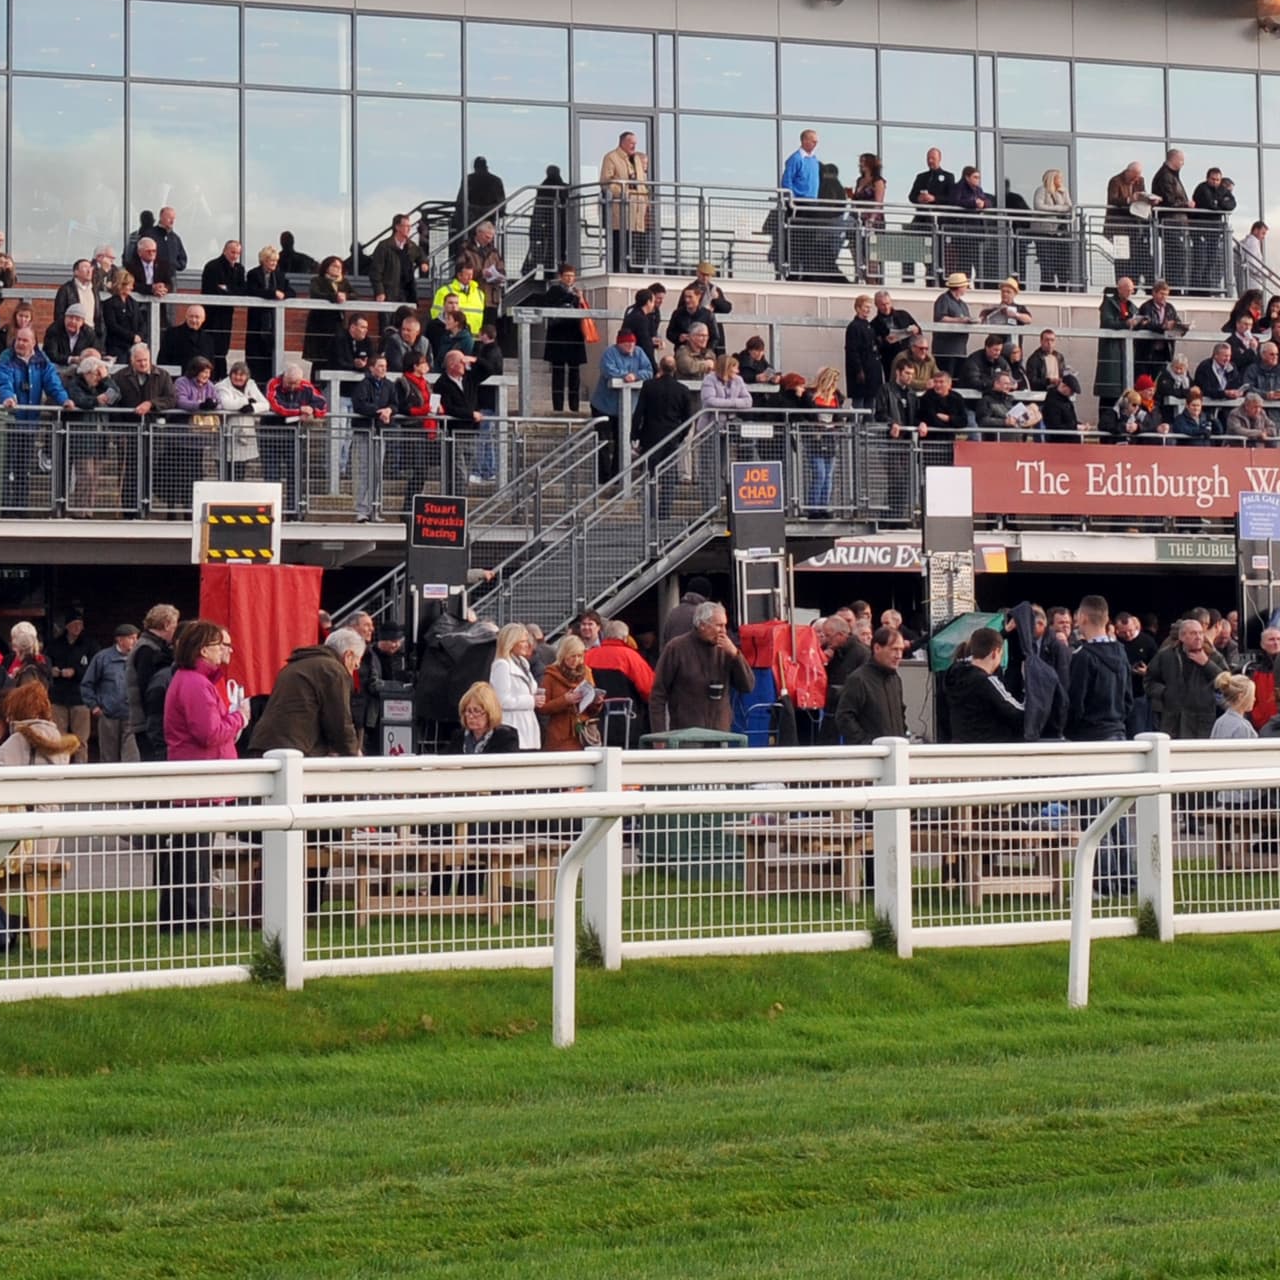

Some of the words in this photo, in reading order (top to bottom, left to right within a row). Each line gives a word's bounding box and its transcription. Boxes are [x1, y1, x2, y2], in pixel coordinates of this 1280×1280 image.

[744, 469, 769, 483] JOE
[1016, 460, 1070, 495] The
[1085, 462, 1230, 508] Edinburgh
[738, 485, 778, 500] CHAD
[424, 502, 457, 514] Stuart
[422, 527, 457, 542] Racing
[1168, 542, 1194, 557] THE
[1195, 543, 1236, 558] JUBIL
